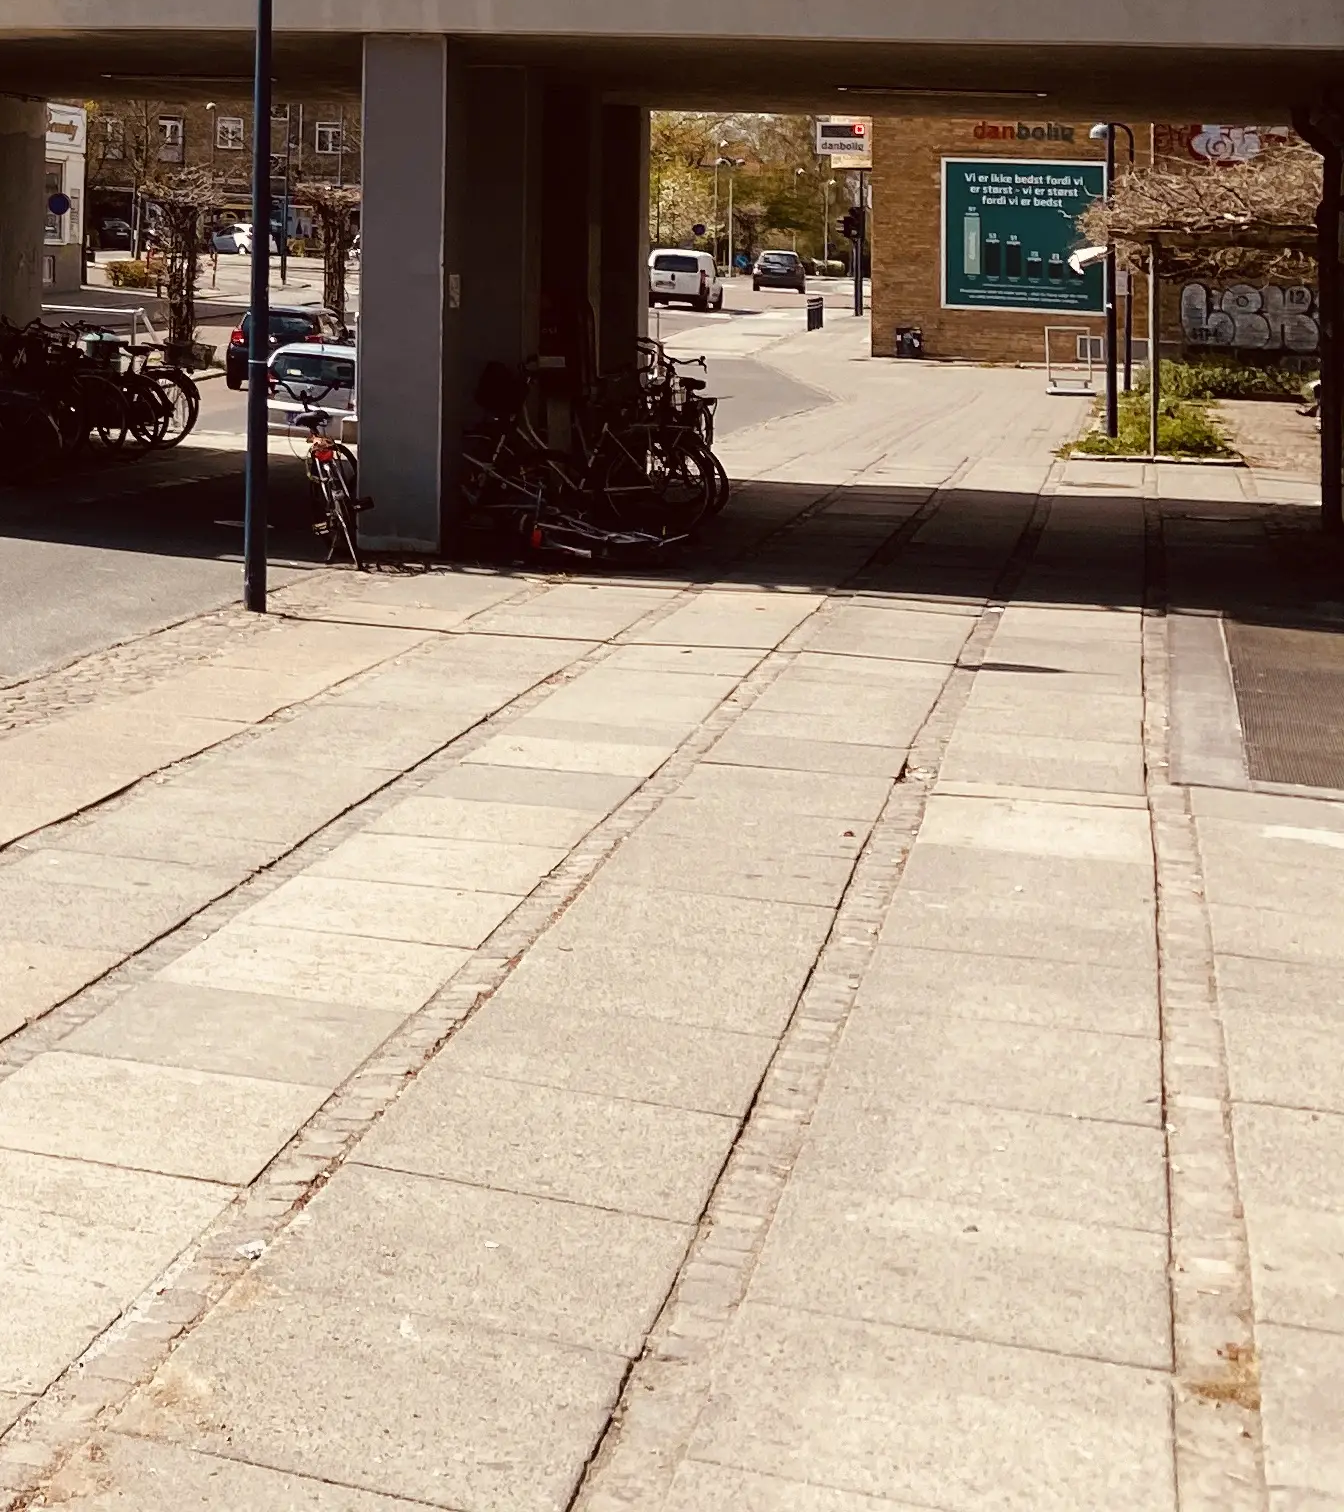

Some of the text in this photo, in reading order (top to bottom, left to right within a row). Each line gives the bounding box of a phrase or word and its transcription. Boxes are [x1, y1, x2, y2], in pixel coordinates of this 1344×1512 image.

[973, 121, 1075, 144] danbolig
[821, 141, 865, 152] danbolig
[964, 172, 1084, 186] Vi er ikke bedst fordi vi
[970, 186, 981, 194] er
[1022, 185, 1033, 195] vi
[1034, 187, 1045, 196] er
[982, 195, 1063, 208] fordi vi er bedst
